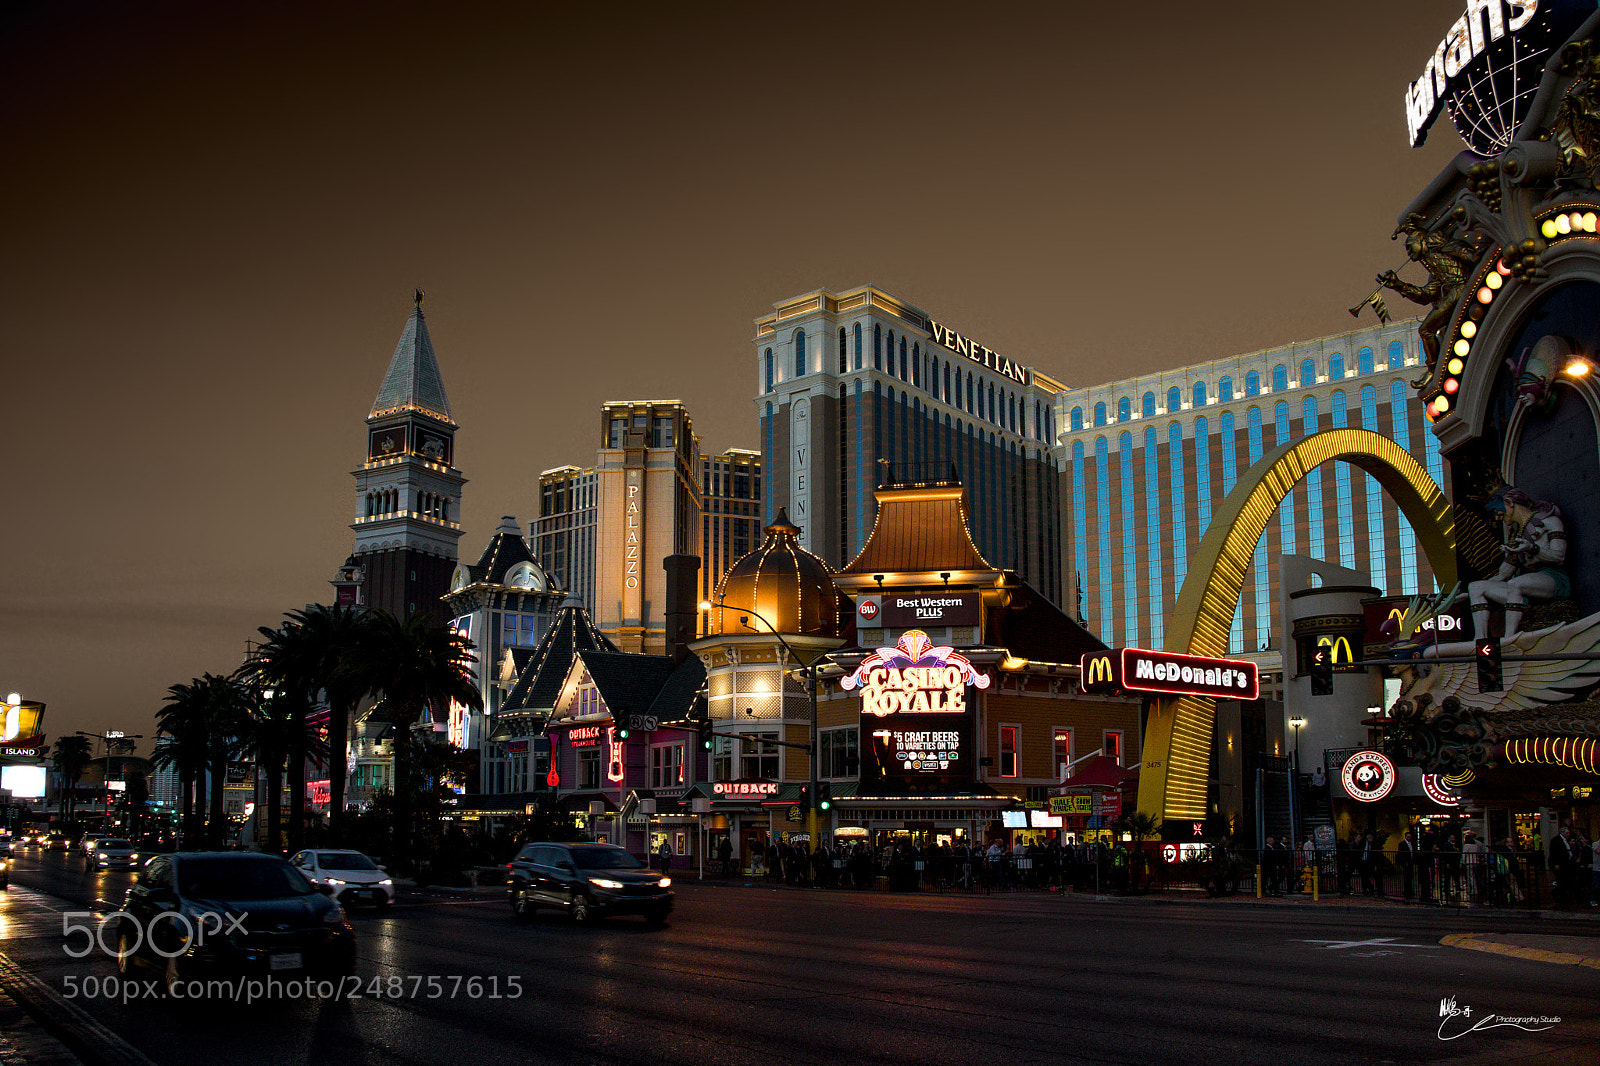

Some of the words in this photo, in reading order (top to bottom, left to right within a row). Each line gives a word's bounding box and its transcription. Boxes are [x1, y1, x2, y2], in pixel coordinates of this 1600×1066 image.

[930, 319, 1026, 385] VENETIAN
[626, 485, 639, 589] PALAZZO
[896, 598, 919, 608] Best
[920, 597, 963, 607] Western
[861, 605, 876, 614] BW
[916, 608, 943, 617] PLUS
[868, 667, 962, 690] CASINO
[1136, 659, 1247, 689] McDonald's
[859, 683, 966, 717] ROYALE
[568, 726, 600, 740] OUTBACK
[893, 731, 903, 742] $5
[904, 731, 931, 742] CRAFT
[932, 731, 959, 742] BEERS
[5, 748, 35, 756] ISLAND
[896, 742, 904, 750] 10
[904, 742, 936, 750] VARIETIES
[937, 742, 946, 750] ON
[947, 742, 959, 750] TAP
[1345, 755, 1364, 775] PANDA
[1365, 754, 1391, 775] EXPRESS
[713, 783, 777, 794] OUTBACK
[1347, 781, 1367, 798] CHINESE
[1368, 782, 1389, 798] KITCHEN
[1054, 798, 1071, 806] HALF
